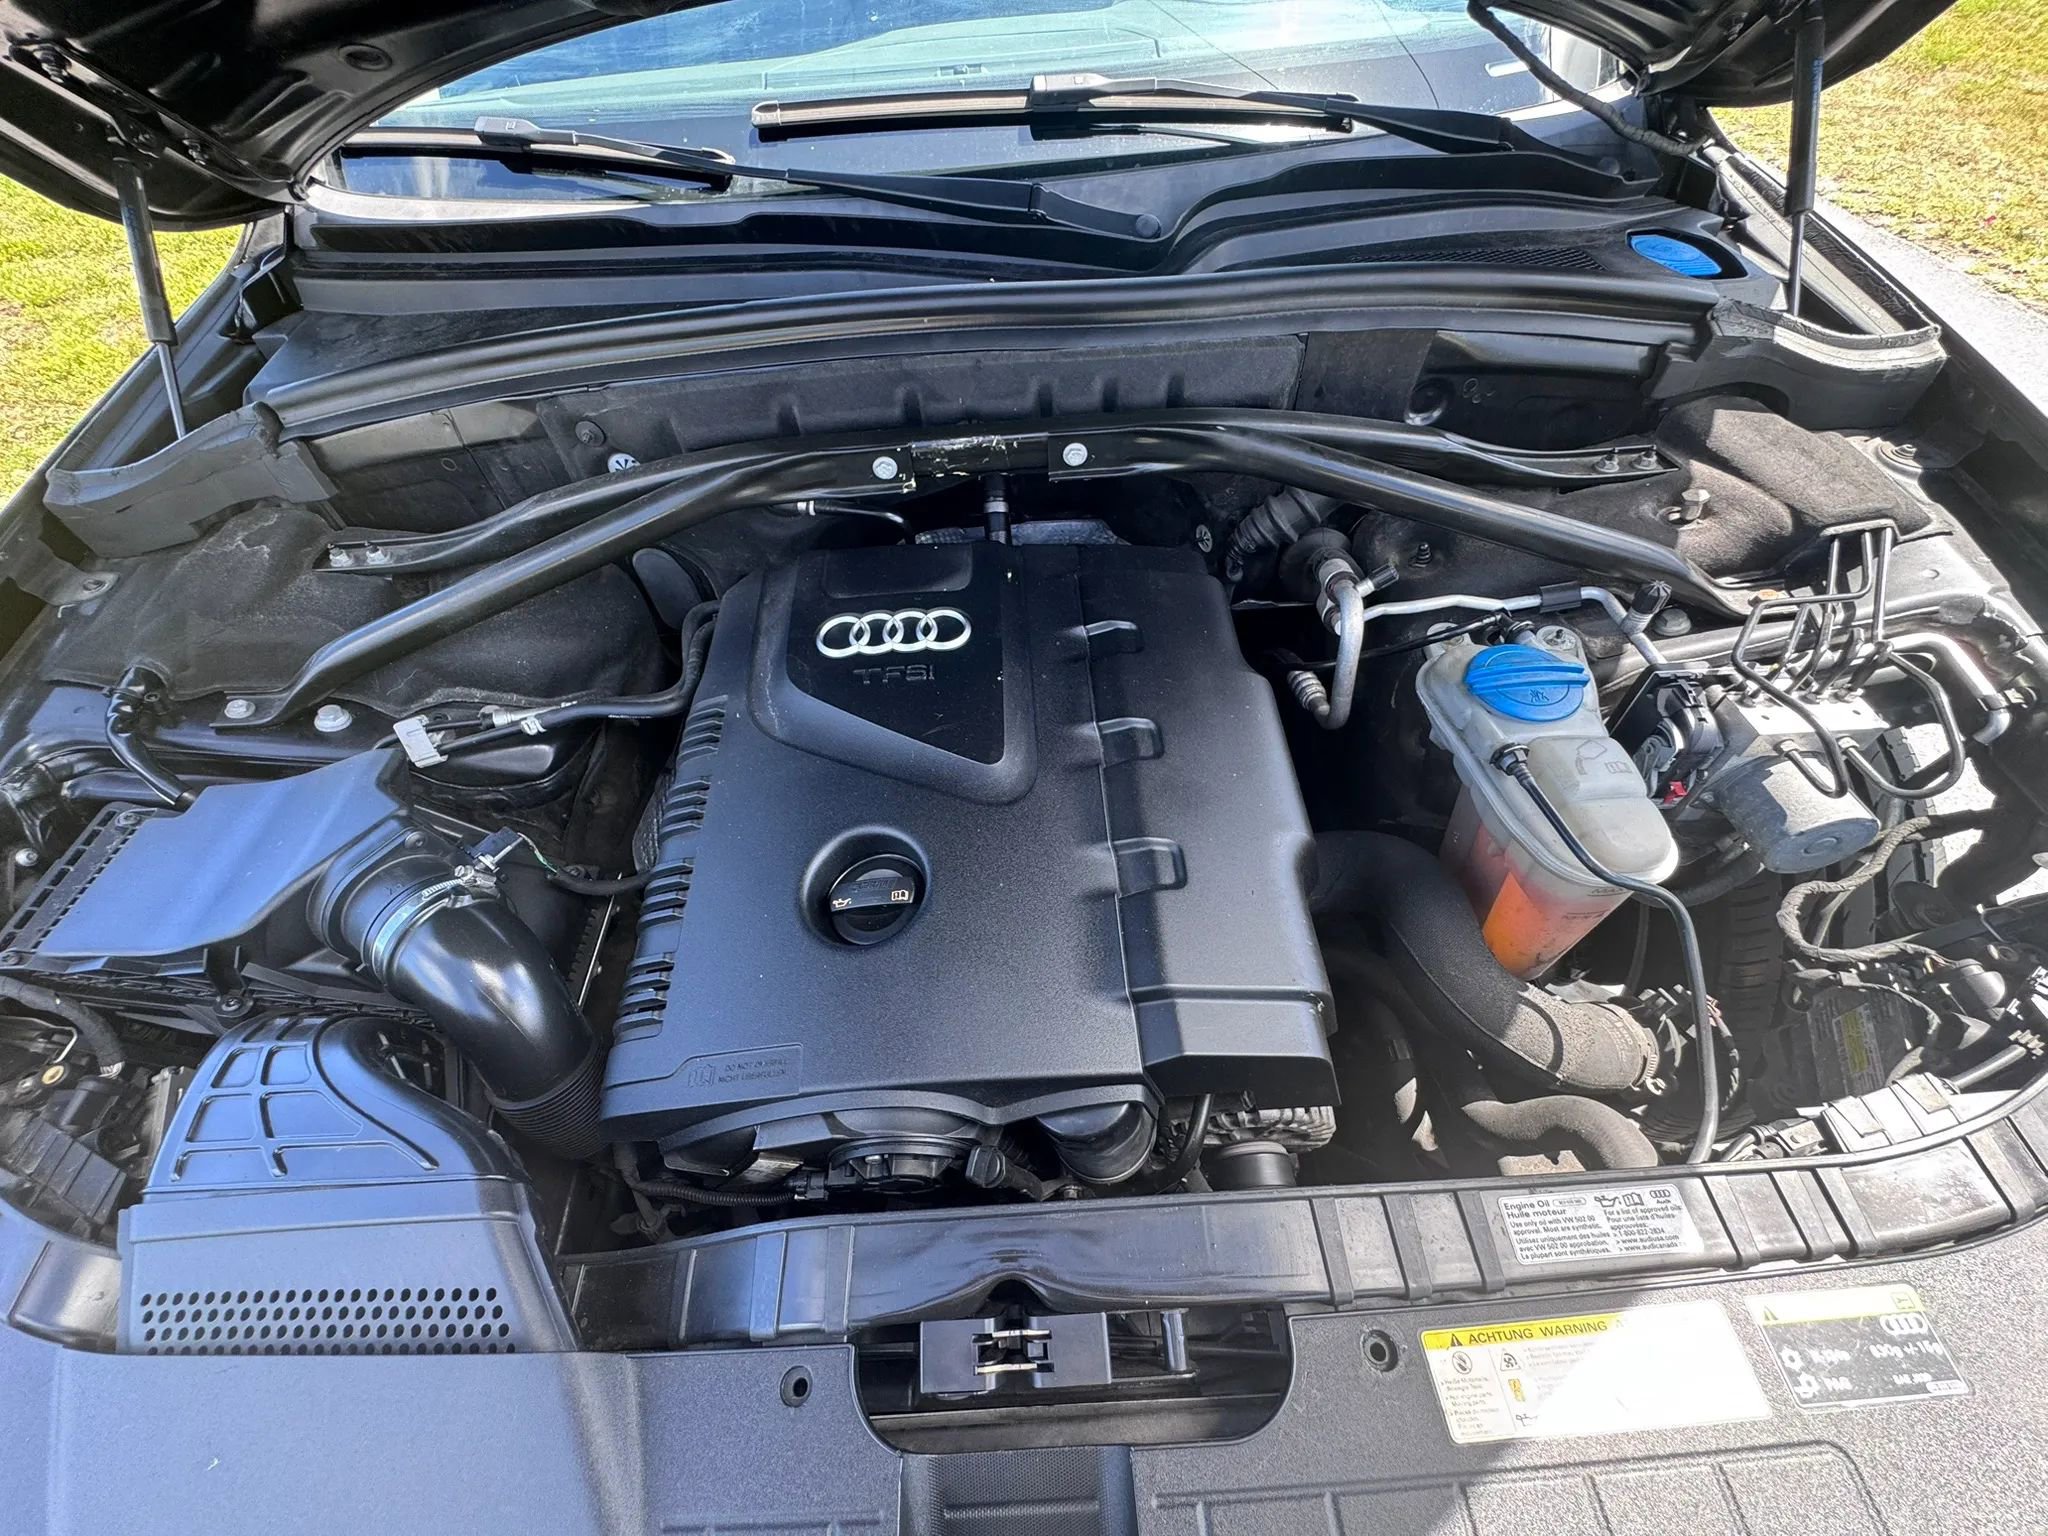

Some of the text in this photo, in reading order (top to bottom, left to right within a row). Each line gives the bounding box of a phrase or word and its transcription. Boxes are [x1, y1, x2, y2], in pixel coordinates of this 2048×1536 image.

[853, 664, 934, 684] TFSI
[1503, 1201, 1535, 1212] Engine
[1537, 1199, 1550, 1208] Oil
[1639, 1205, 1669, 1214] approved
[1506, 1209, 1567, 1219] Huile moteur
[1606, 1215, 1622, 1223] Pour
[1523, 1219, 1538, 1228] only
[1539, 1218, 1547, 1226] oil
[1548, 1217, 1562, 1225] with
[1562, 1216, 1575, 1224] VW
[1575, 1215, 1585, 1223] 502
[1543, 1225, 1560, 1233] Most
[1539, 1234, 1578, 1244] uniquement
[1578, 1232, 1591, 1240] des
[1591, 1231, 1610, 1239] huiles
[1547, 1242, 1559, 1250] 502
[1530, 1250, 1553, 1260] plupart
[1553, 1249, 1569, 1257] sont
[1468, 1328, 1533, 1345] ACHTUNG
[1539, 1321, 1608, 1338] WARNING
